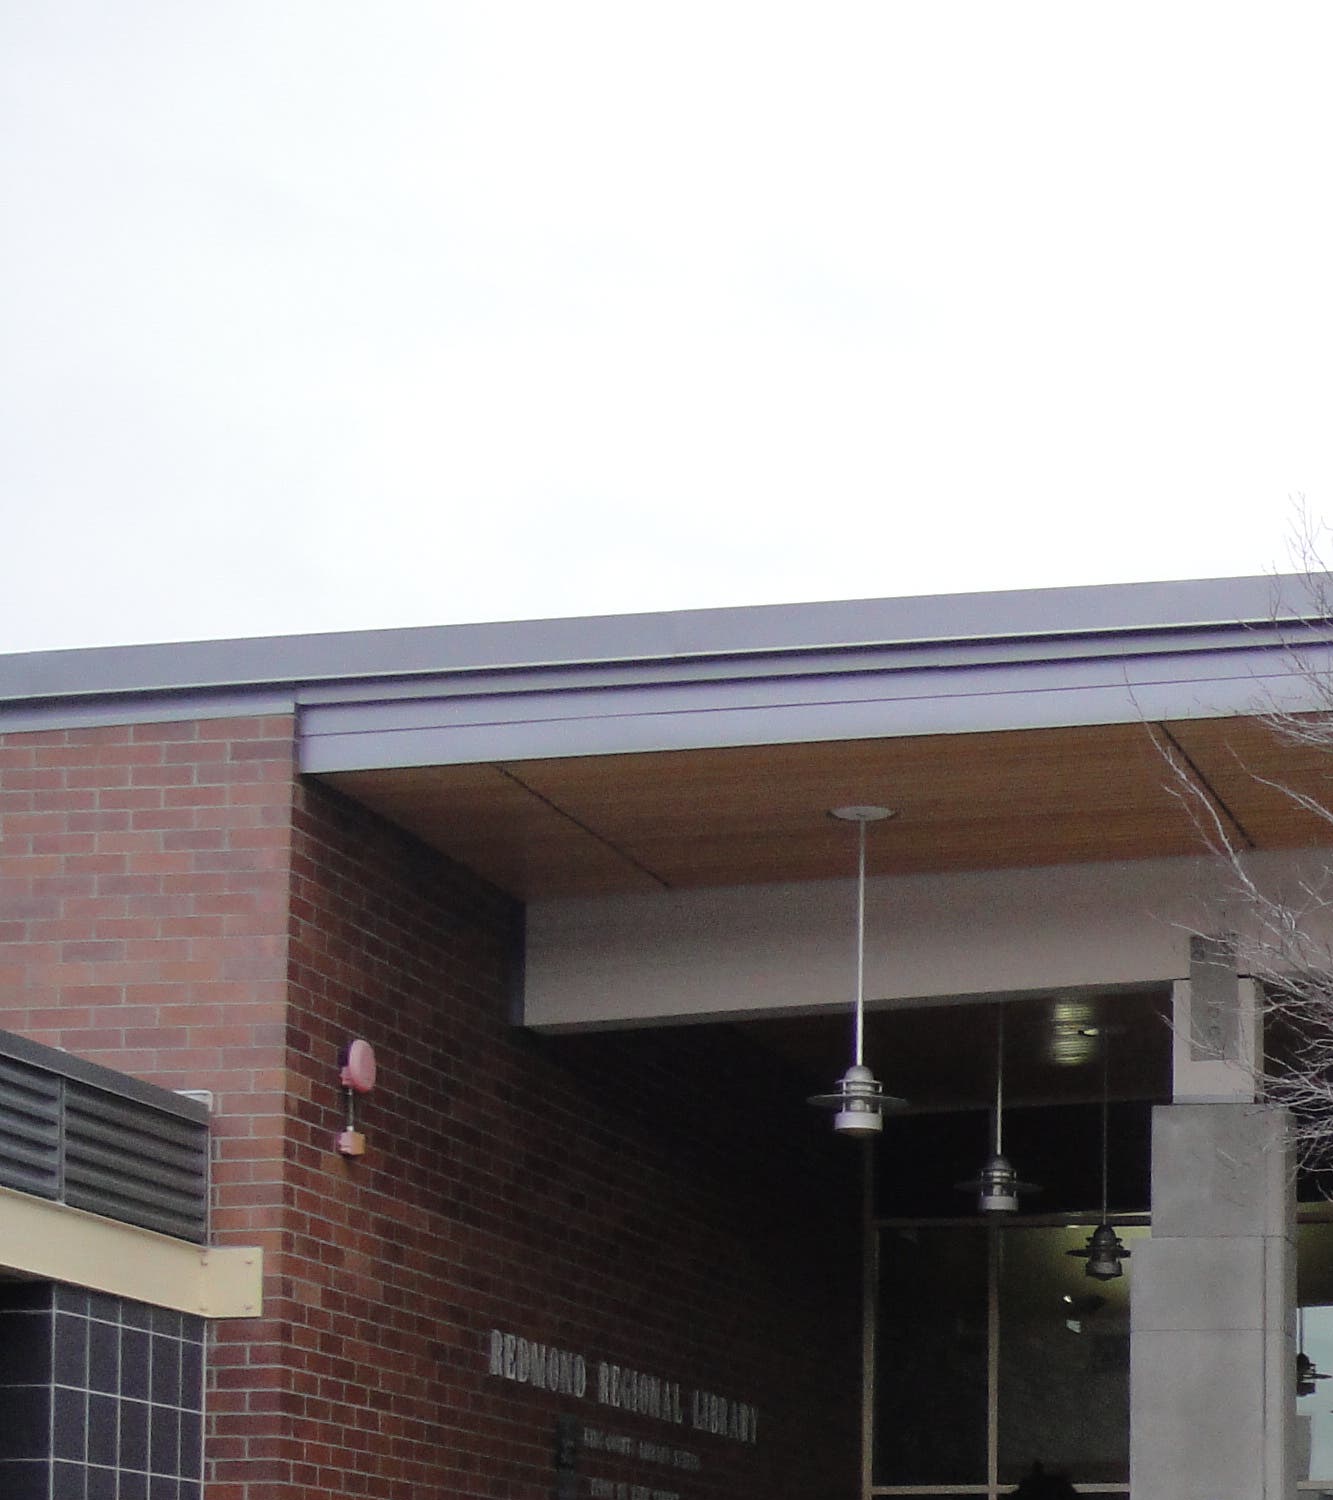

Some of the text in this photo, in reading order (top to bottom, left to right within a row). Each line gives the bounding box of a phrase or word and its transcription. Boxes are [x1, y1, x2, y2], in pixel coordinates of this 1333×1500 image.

[489, 1329, 759, 1445] REDMOND REGIONAL LIBRARY
